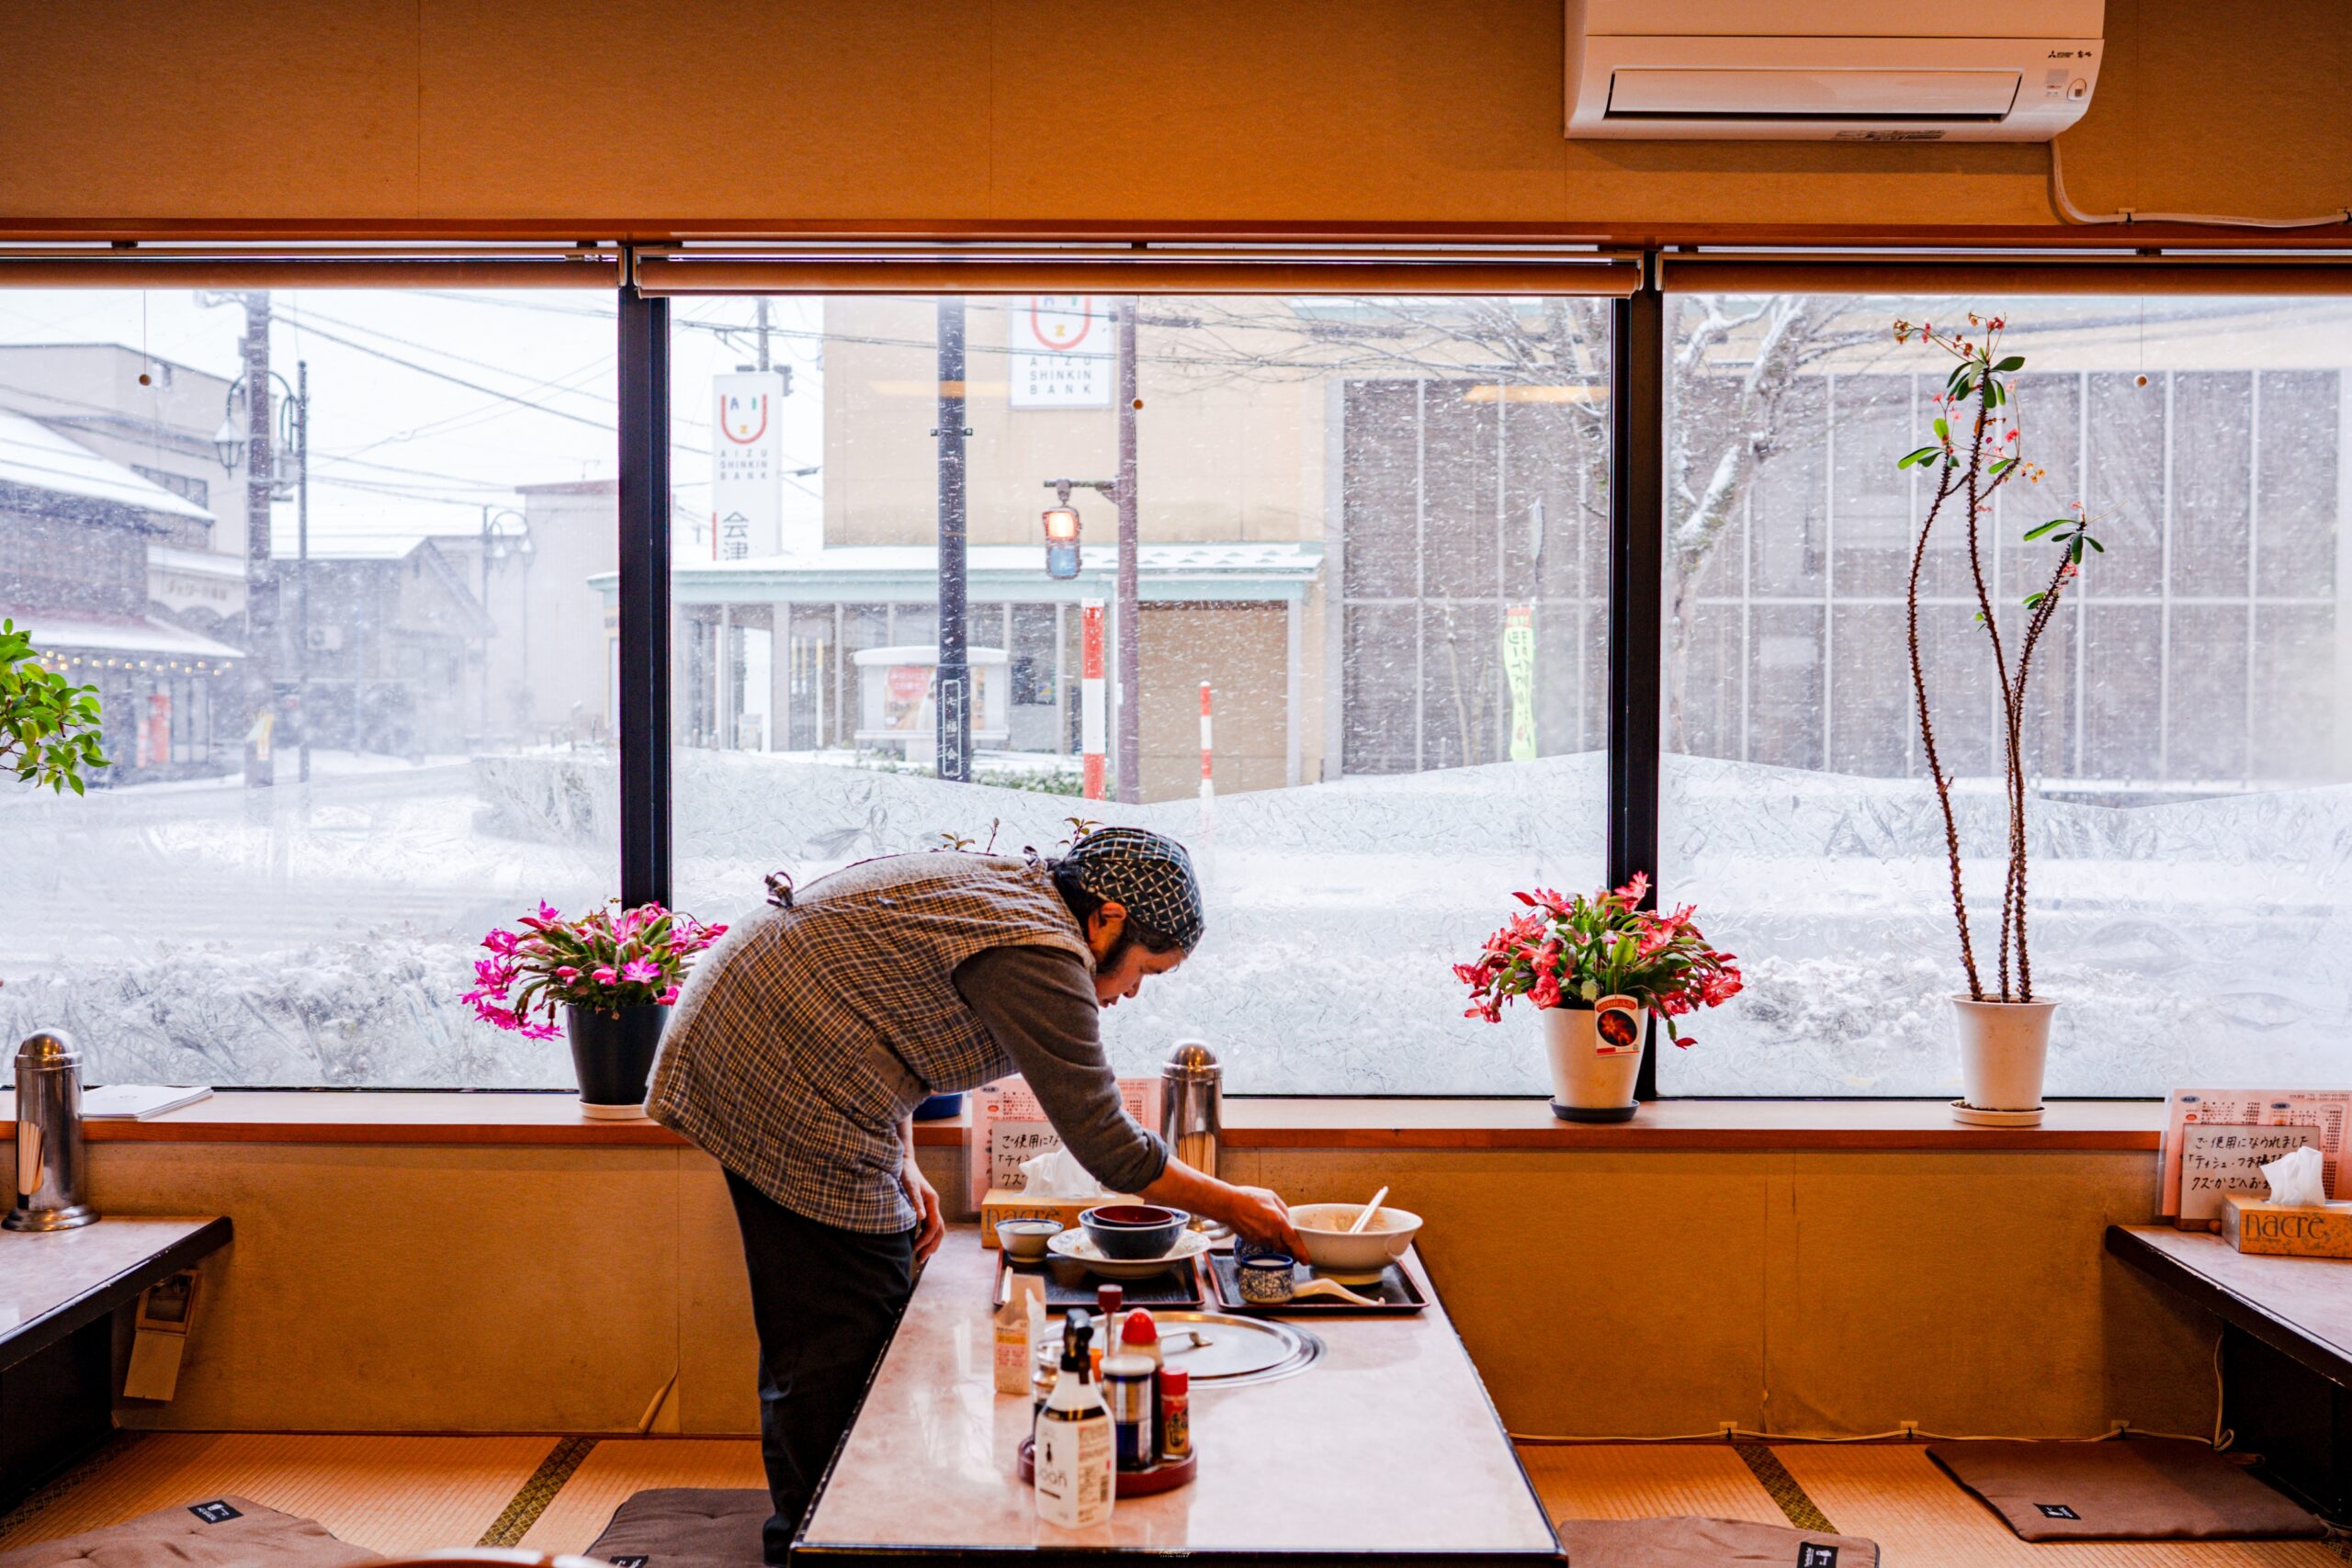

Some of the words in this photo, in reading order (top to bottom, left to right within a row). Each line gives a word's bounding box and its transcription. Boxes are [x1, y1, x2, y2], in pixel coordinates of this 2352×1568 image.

[1029, 355, 1091, 367] AIZU
[1029, 370, 1091, 380] SHINKIN
[1029, 384, 1091, 395] BANK
[719, 449, 768, 457] AIZU
[719, 460, 768, 469] SHINKIN
[719, 472, 768, 480] BANK
